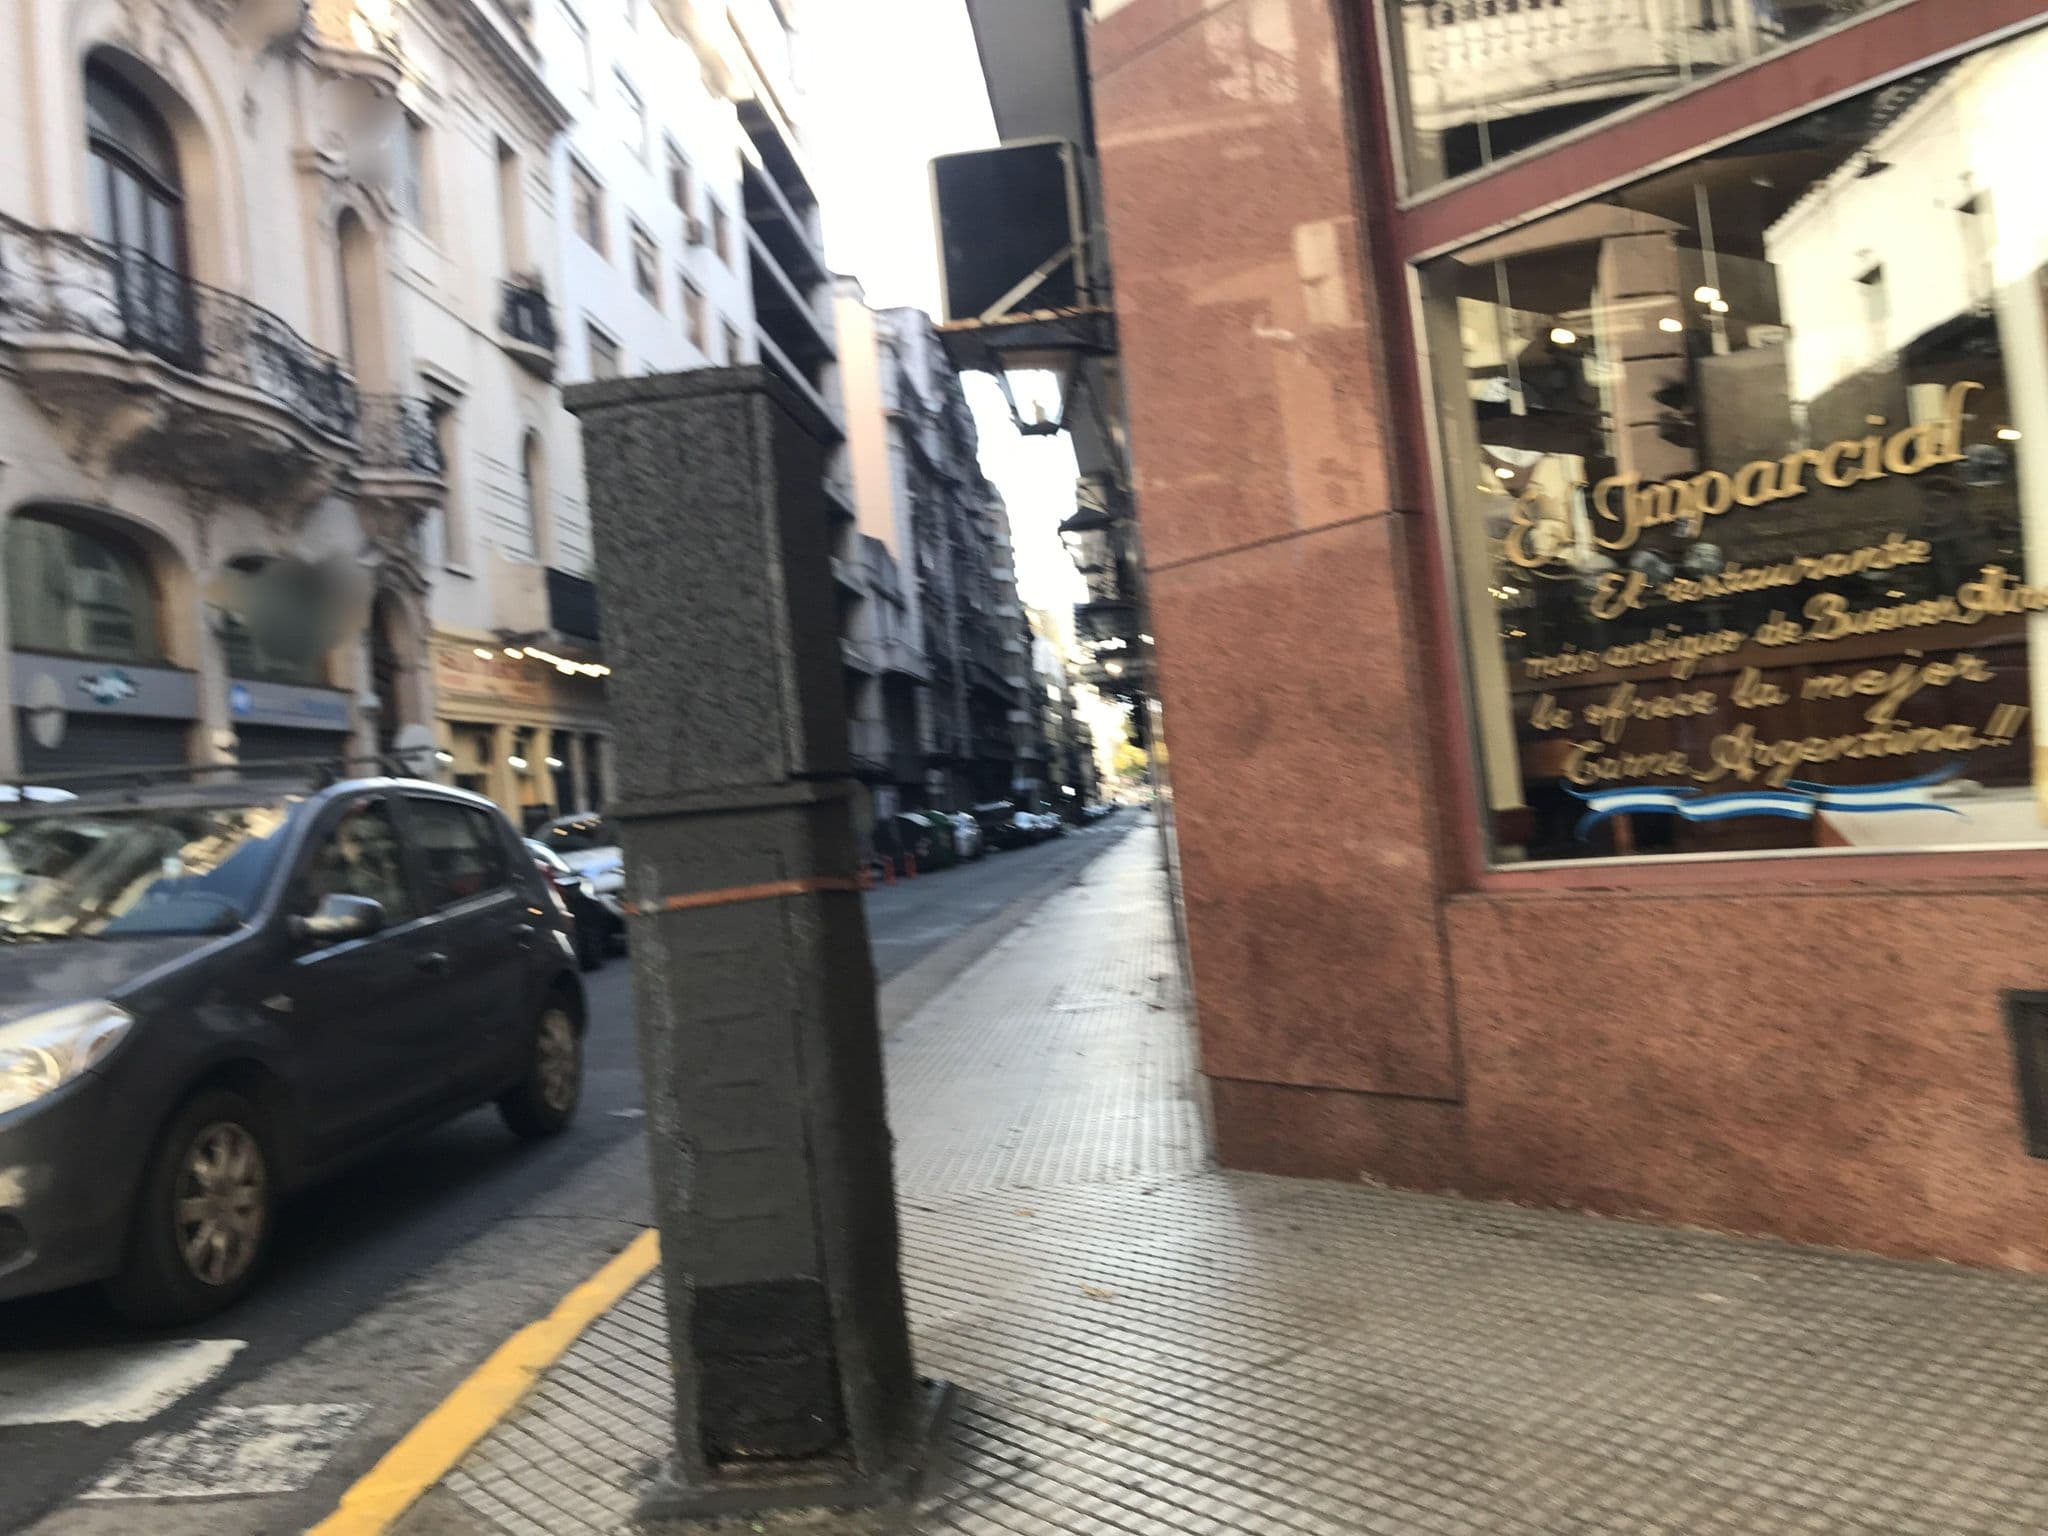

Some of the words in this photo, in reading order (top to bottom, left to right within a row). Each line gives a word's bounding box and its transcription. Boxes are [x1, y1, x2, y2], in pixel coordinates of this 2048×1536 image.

[1593, 380, 1984, 550] Imparcial
[1591, 571, 1648, 619] El
[1601, 623, 1745, 681] antiguo
[1754, 609, 1801, 647] de
[1803, 592, 1962, 640] Buenos
[1729, 666, 1791, 707] la
[1800, 648, 1998, 726] mejor
[1564, 739, 1690, 785] Carne
